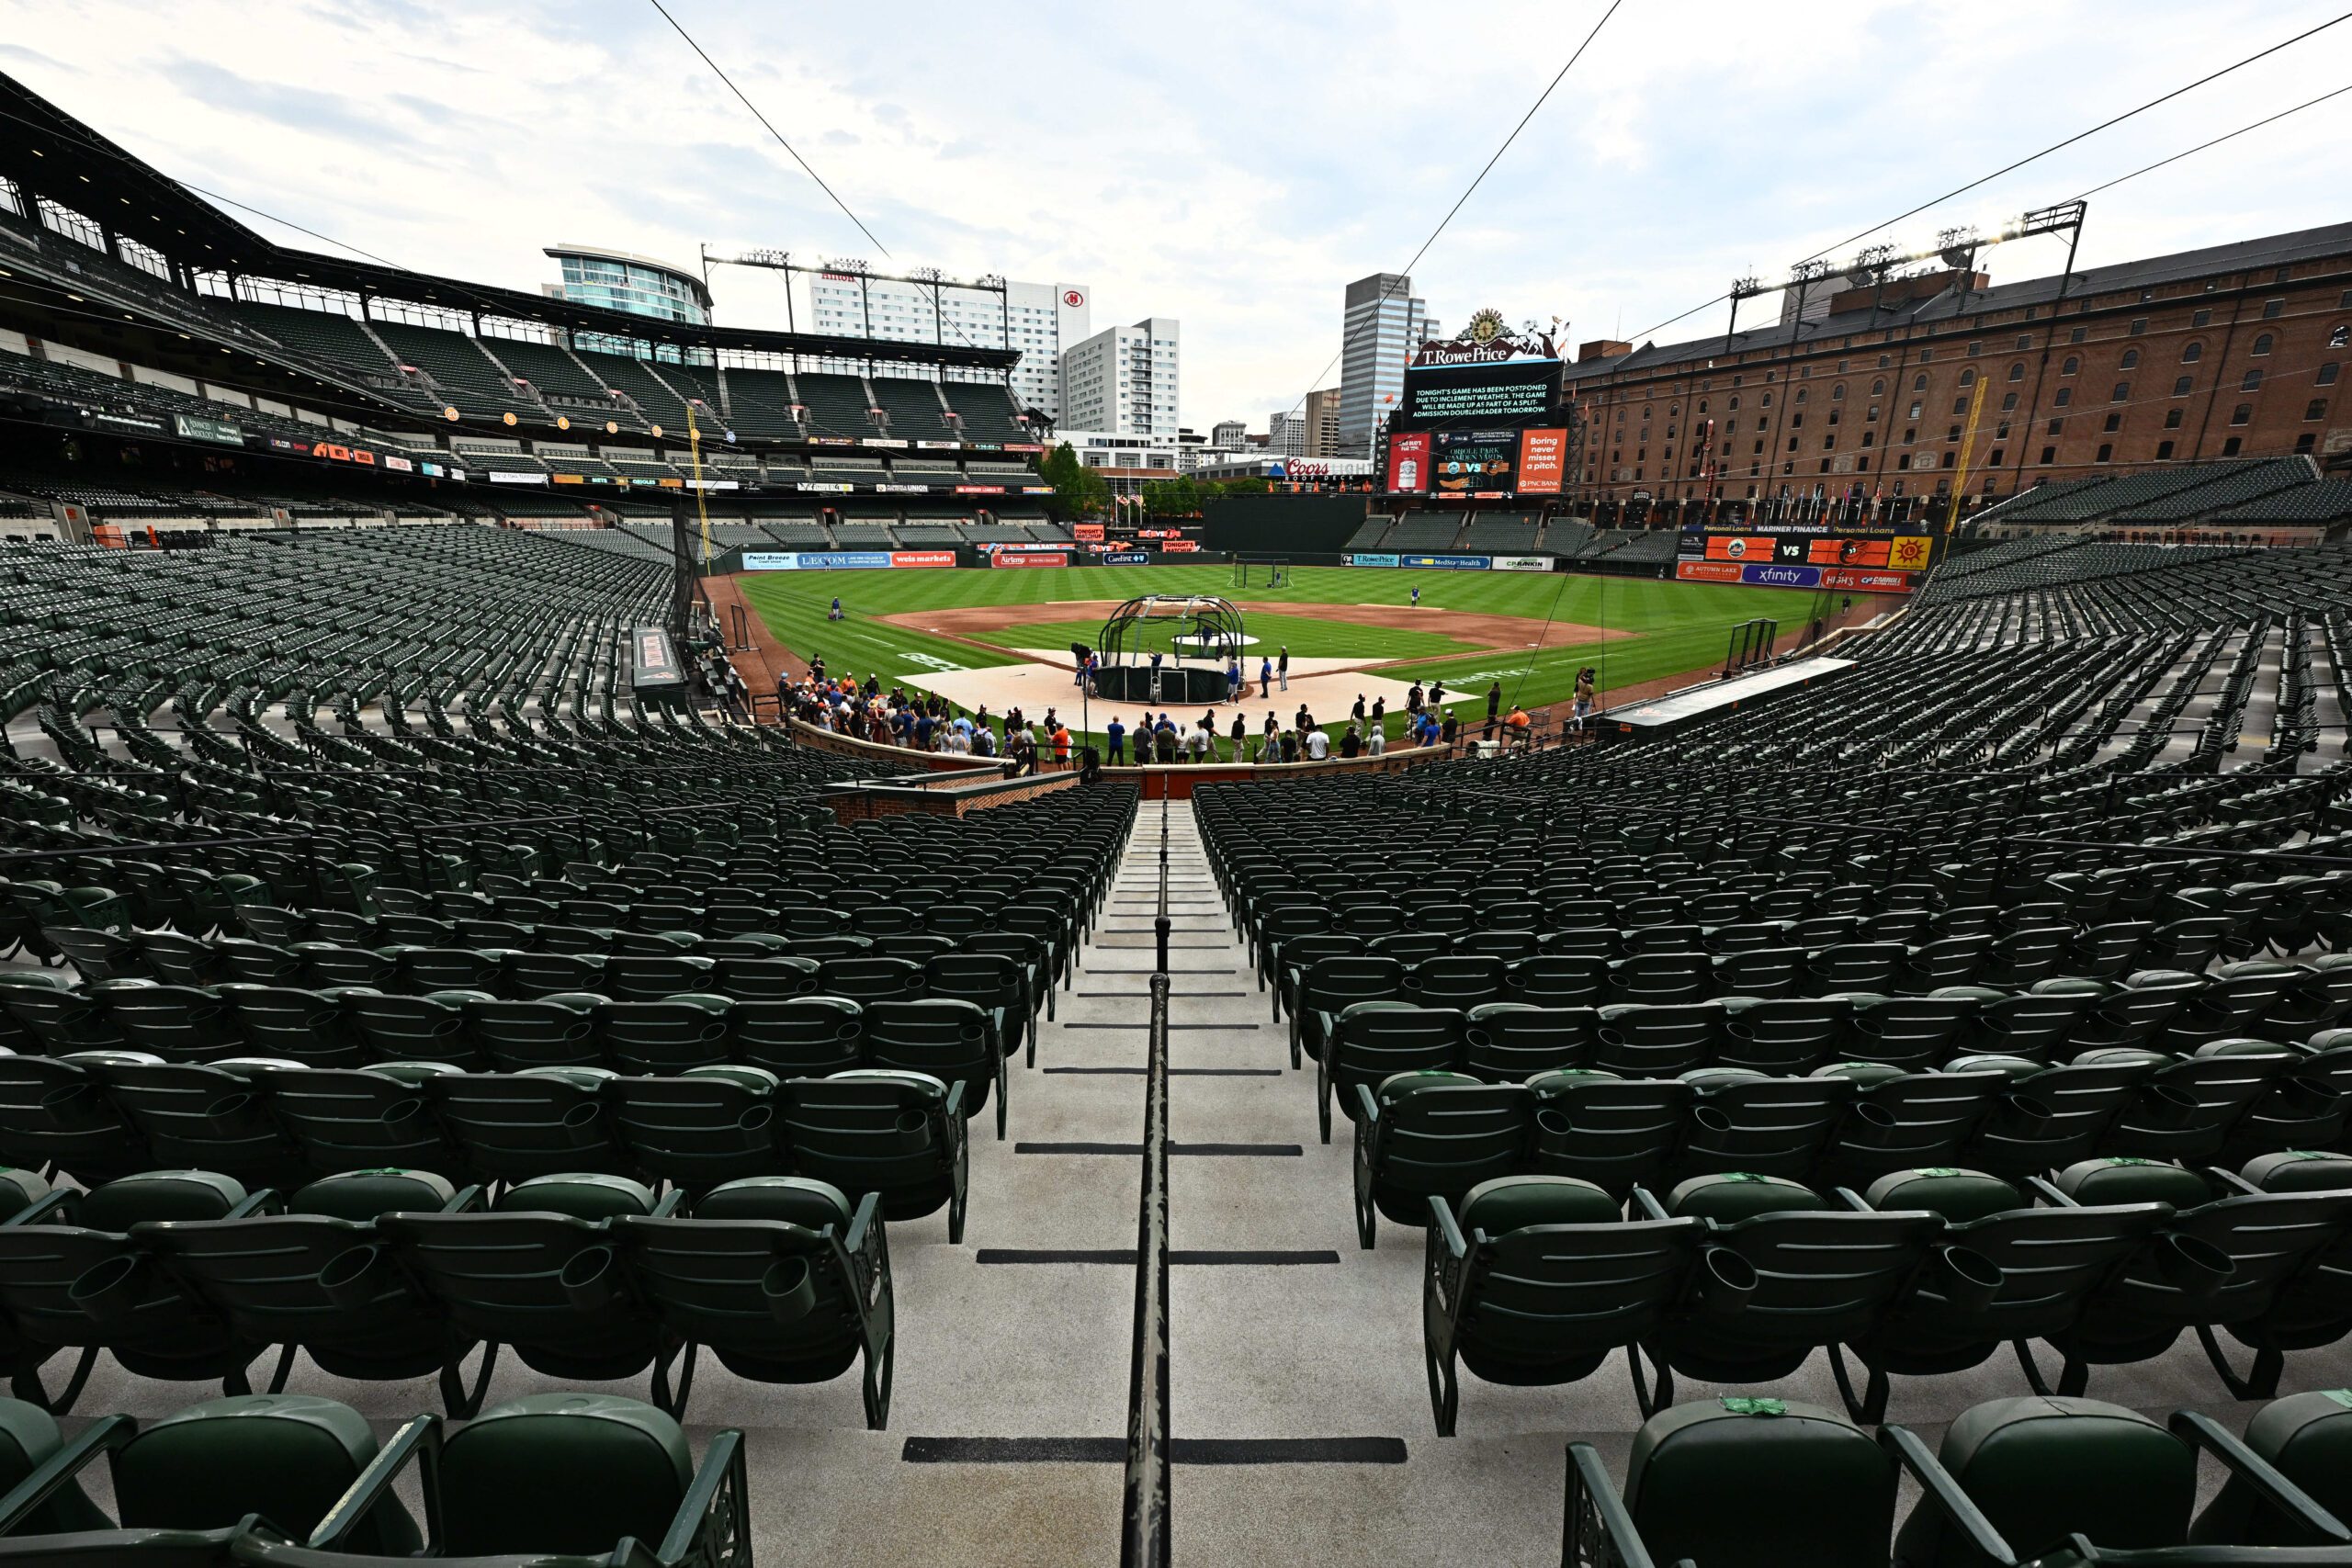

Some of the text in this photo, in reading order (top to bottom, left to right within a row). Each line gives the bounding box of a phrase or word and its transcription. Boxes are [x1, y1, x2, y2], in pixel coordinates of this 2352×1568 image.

[1505, 384, 1547, 392] POSTPONED
[1450, 408, 1506, 416] DOUBLEHEADER
[1506, 406, 1546, 414] TOMORROW.
[1530, 436, 1558, 446] Boring
[1286, 458, 1374, 475] Coors LIGHT
[1465, 463, 1481, 473] VS
[1533, 461, 1558, 471] pitch.
[907, 484, 928, 492] UNION
[1782, 545, 1800, 557] VS
[916, 554, 951, 562] markets
[1001, 556, 1025, 564] Airtemp
[1108, 552, 1133, 563] CareFirst
[1758, 568, 1801, 583] xfinity
[1826, 575, 1855, 587] HIGH'S
